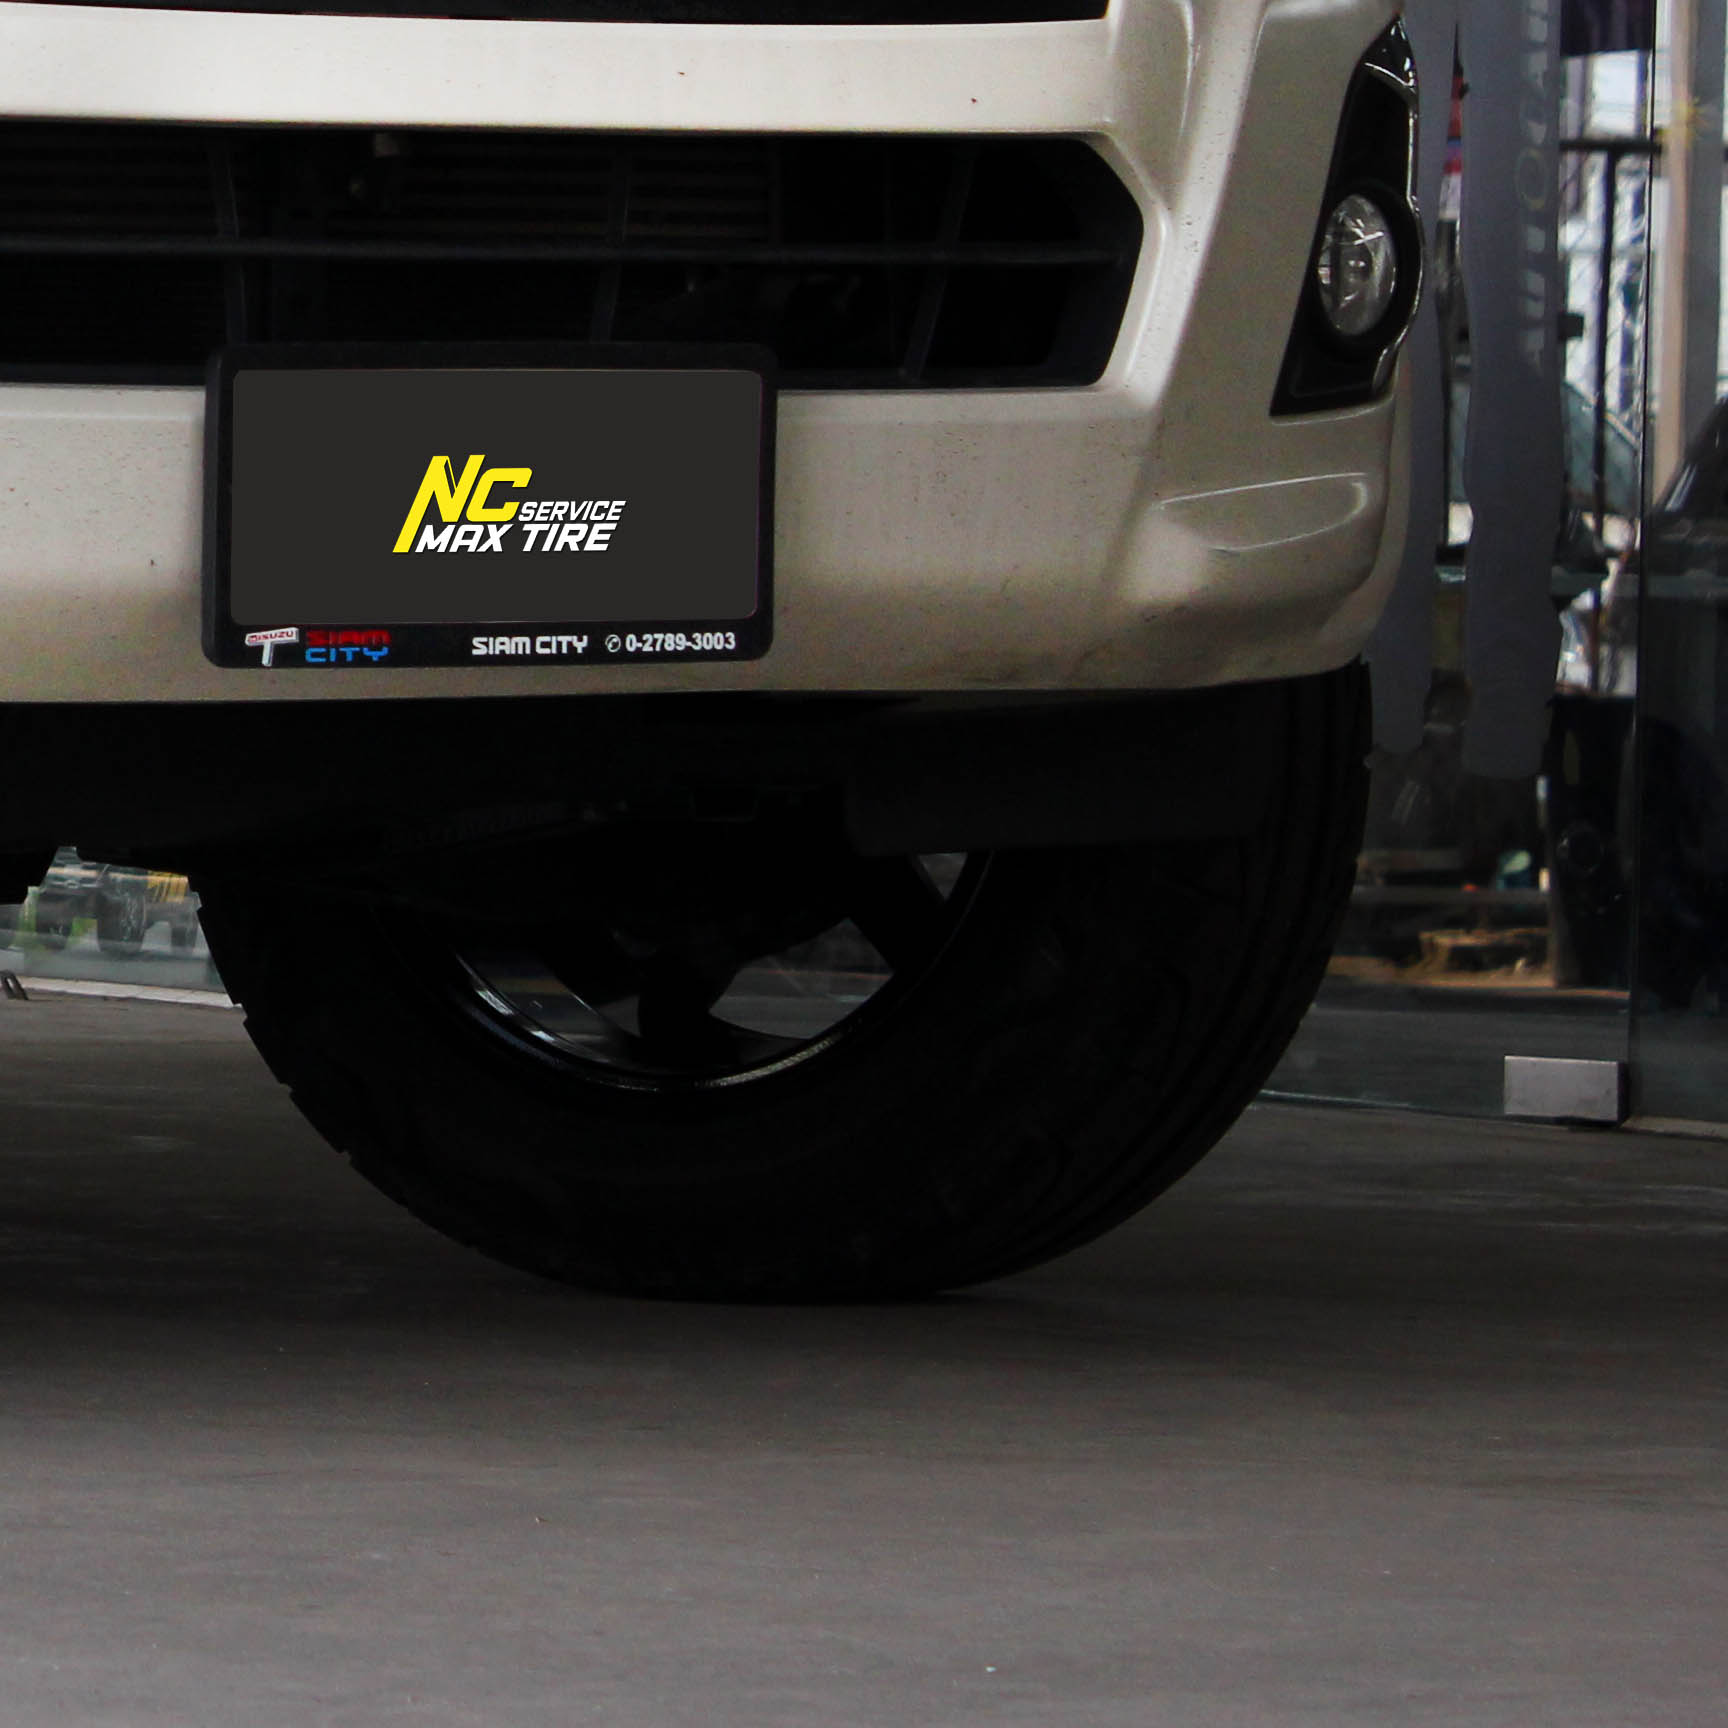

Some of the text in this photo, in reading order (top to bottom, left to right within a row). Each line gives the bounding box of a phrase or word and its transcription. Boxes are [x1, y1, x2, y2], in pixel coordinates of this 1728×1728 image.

[306, 629, 391, 645] SIAM
[471, 631, 736, 656] SIAM CITY 0-2789-3003
[304, 646, 390, 663] CITY
